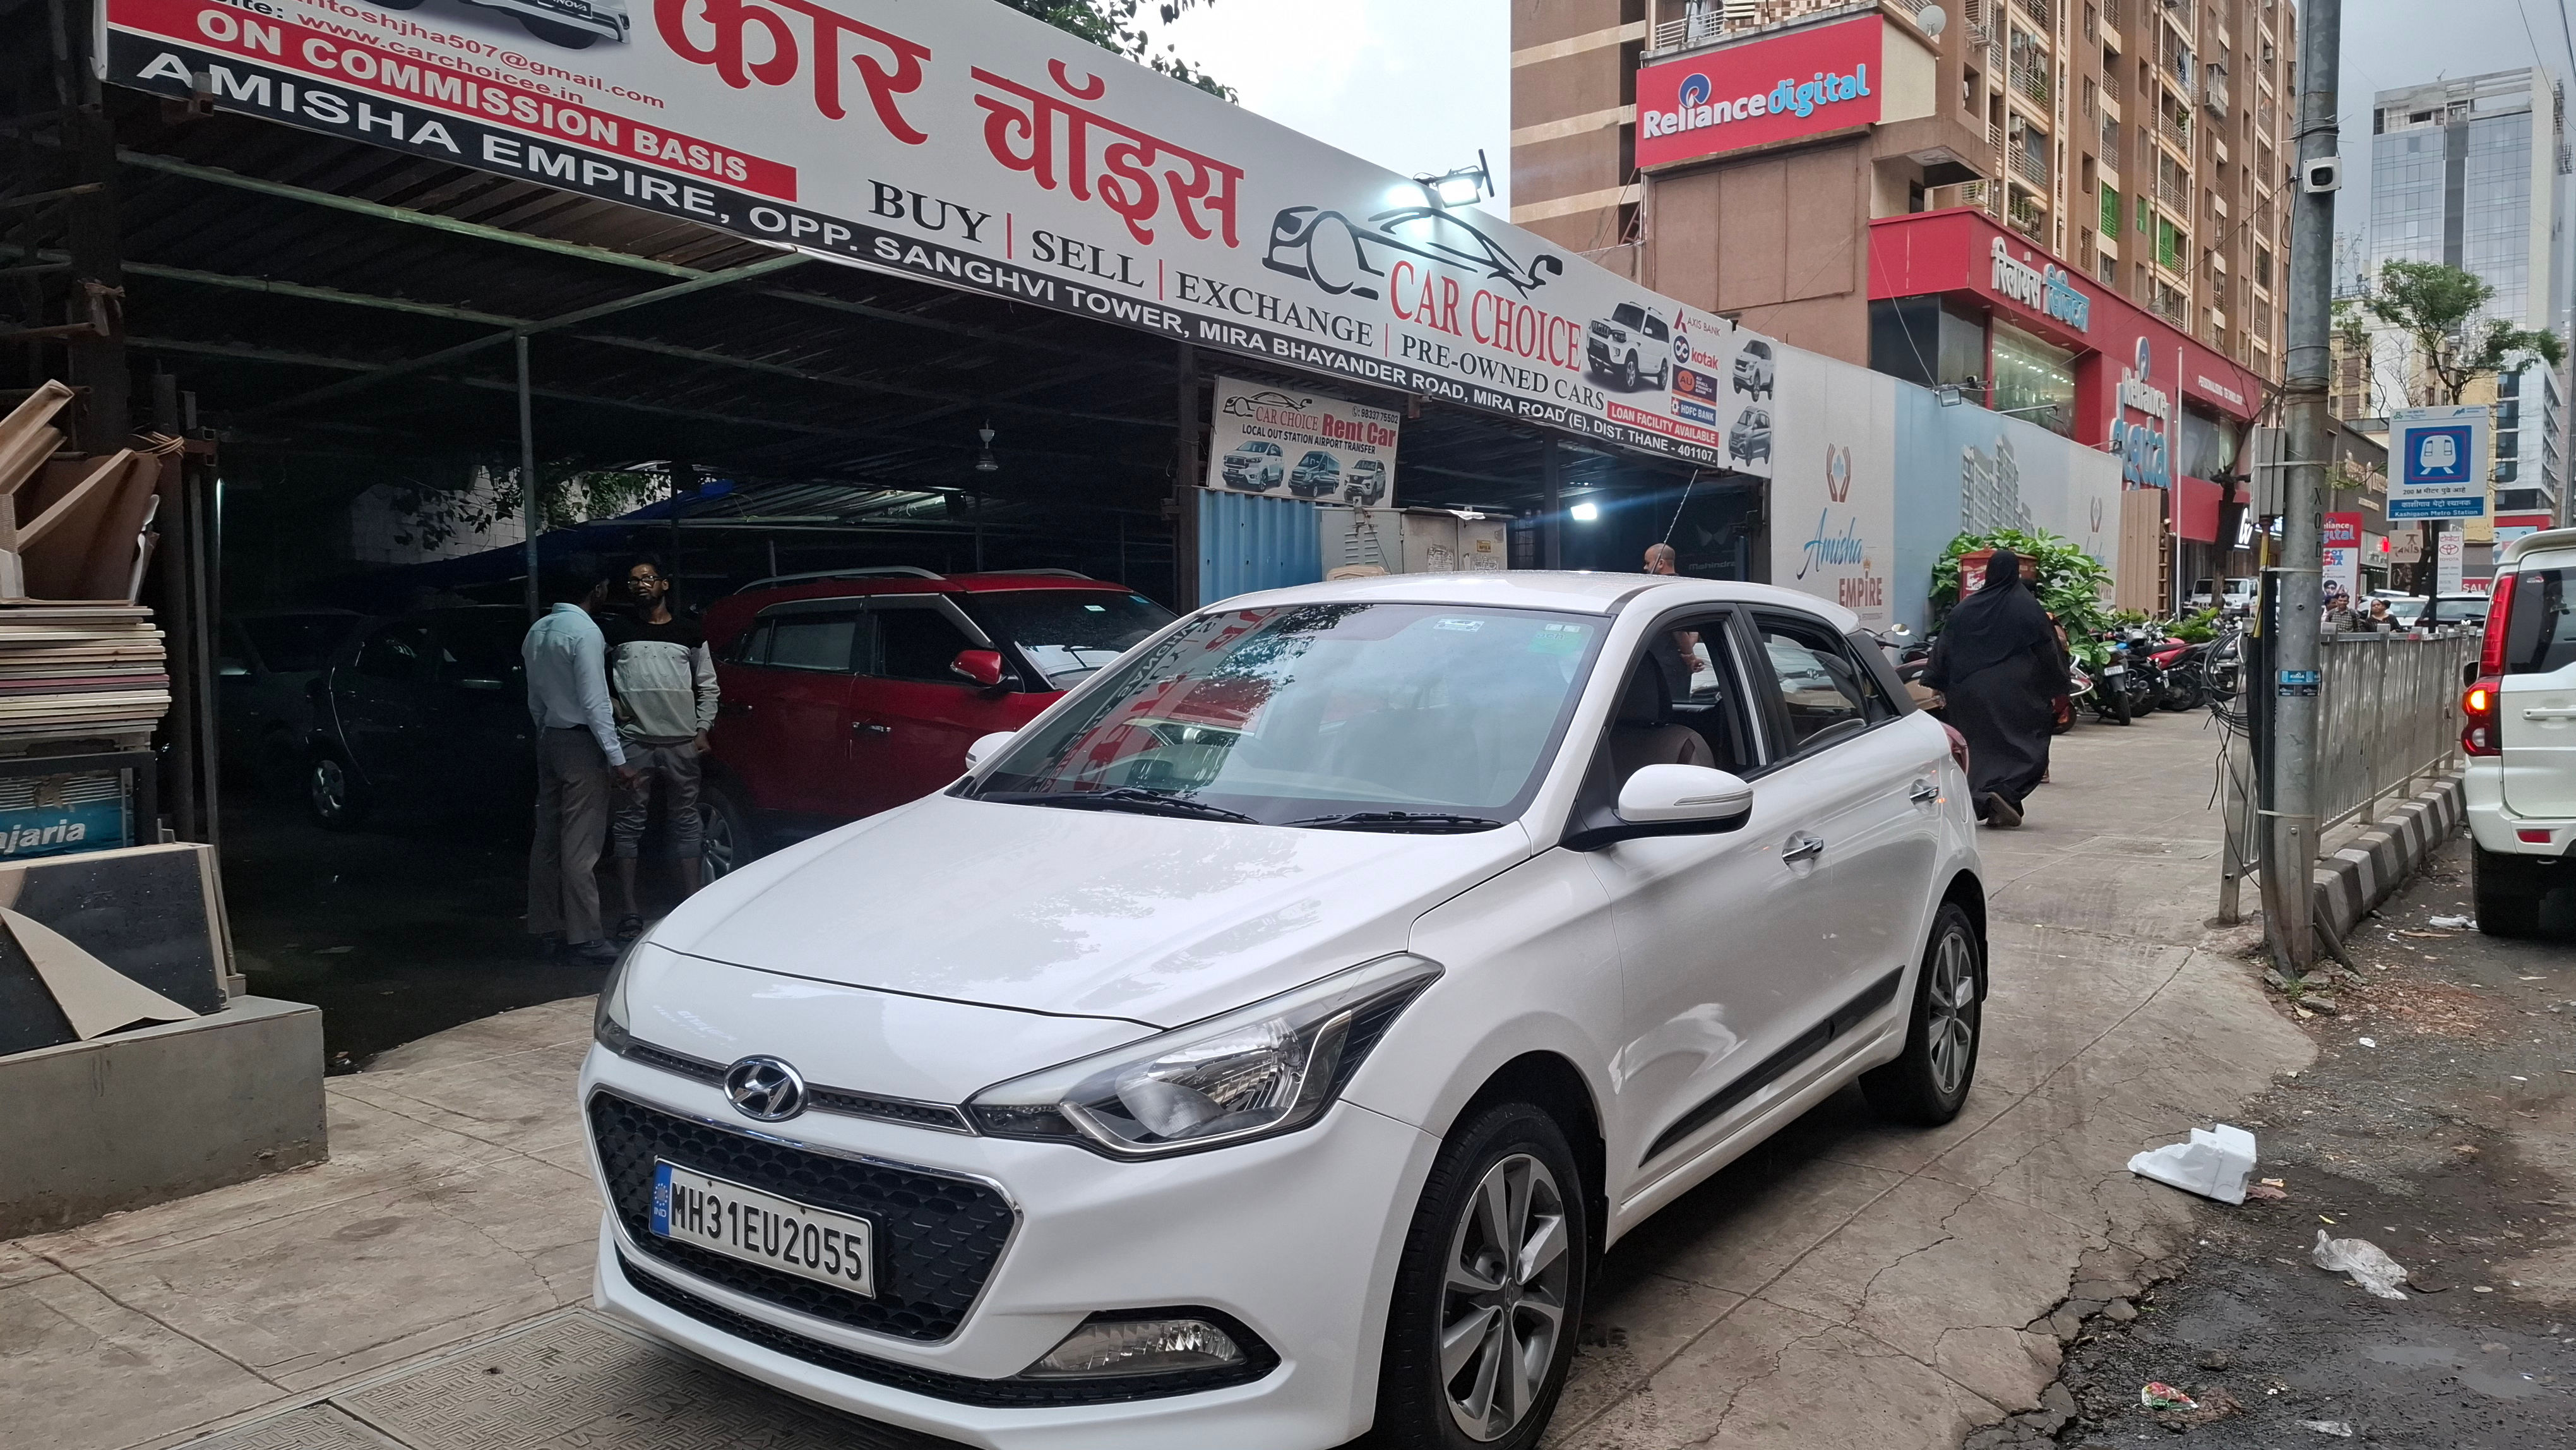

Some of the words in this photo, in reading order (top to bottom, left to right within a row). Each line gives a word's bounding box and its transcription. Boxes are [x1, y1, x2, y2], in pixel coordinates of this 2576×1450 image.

[553, 0, 588, 11] NOVA
[297, 0, 665, 109] ntoshjha507@gmail.com
[297, 13, 583, 104] www.carchoicee.in
[197, 9, 281, 56] ON
[302, 38, 617, 147] COMMISSION
[634, 128, 748, 182] BASIS
[1643, 93, 1766, 139] Reliance
[1767, 63, 1870, 117] digital
[653, 0, 931, 145] कार
[970, 58, 1244, 248] चॉइस
[136, 52, 461, 154] AMISHA
[482, 134, 730, 224] EMPIRE,
[749, 207, 858, 251] OPP.
[874, 237, 1054, 301] SANGHVI
[1065, 285, 1190, 339] TOWER,
[1200, 321, 1266, 352] MIRA
[1273, 336, 1406, 385] BHAYANDER
[1412, 373, 1469, 404] ROAD,
[1473, 387, 1514, 414] MIRA
[1518, 401, 1565, 422] ROAD
[1569, 412, 1590, 432] (E),
[1594, 420, 1625, 441] DIST.
[1628, 430, 1668, 452] THANE
[1678, 444, 1716, 464] 401107.
[868, 179, 992, 244] BUY
[1032, 229, 1145, 288] SELL
[1176, 270, 1373, 347] EXCHANGE
[1401, 333, 1549, 394] PRE-OWNED
[1554, 378, 1605, 412] CARS
[1390, 260, 1462, 337] CAR
[1471, 288, 1582, 373] CHOICE
[1687, 317, 1702, 330] AXIS
[1703, 323, 1721, 337] BANK
[1691, 347, 1719, 370] kotak
[1679, 376, 1693, 385] AU
[2122, 367, 2168, 420] Reliance
[1255, 406, 1277, 426] CAR
[1280, 410, 1319, 432] CHOICE
[1321, 413, 1364, 442] Rent
[1366, 421, 1397, 447] Car
[1611, 408, 1635, 422] LOAN
[1637, 414, 1673, 433] FACILITY
[1674, 422, 1715, 444] AVAILABLE
[1681, 404, 1697, 416] HDFC
[1698, 409, 1714, 421] BANK
[1242, 423, 1265, 436] LOCAL
[1267, 429, 1283, 440] OUT
[1284, 431, 1313, 445] STATION
[1314, 436, 1344, 449] AIRPORT
[1344, 440, 1376, 455] TRANSFER
[1796, 507, 1863, 580] Amisha
[2323, 525, 2355, 544] gital
[2392, 544, 2419, 557] TANIS
[2462, 583, 2488, 592] SAL
[0, 819, 85, 853] jaria
[654, 1206, 667, 1218] IND
[671, 1181, 862, 1281] MH31EU2055
